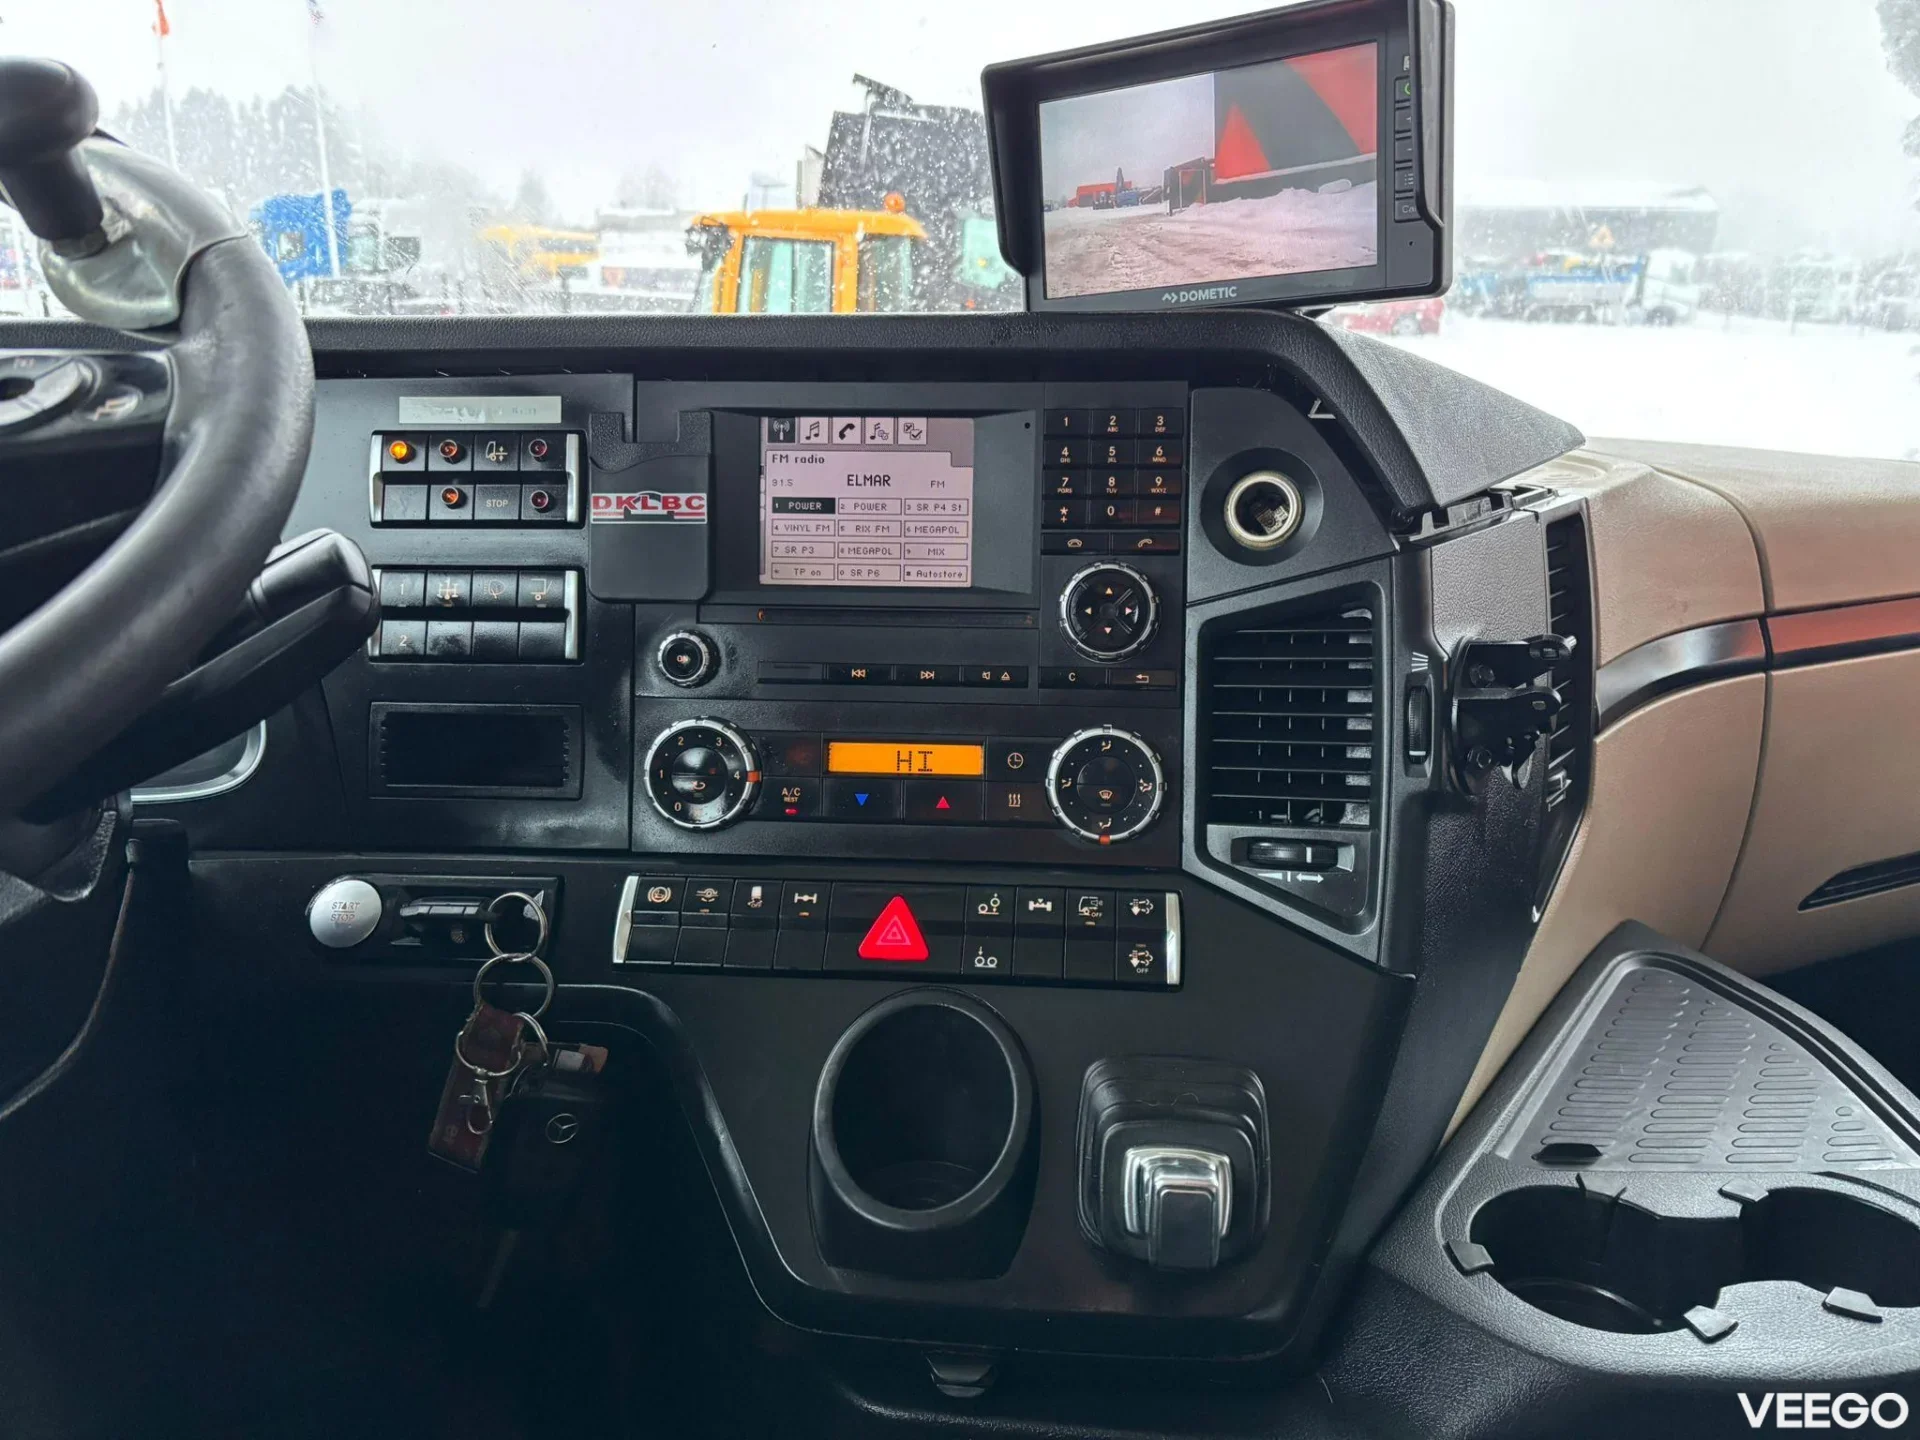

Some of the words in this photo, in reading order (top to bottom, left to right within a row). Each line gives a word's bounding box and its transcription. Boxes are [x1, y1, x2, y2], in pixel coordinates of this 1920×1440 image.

[1180, 286, 1237, 303] DOMETIC
[1063, 417, 1069, 427] 1
[1109, 415, 1117, 426] 2
[1156, 415, 1164, 426] 3
[1061, 446, 1069, 457] 4
[1108, 446, 1116, 456] 5
[1156, 445, 1163, 456] 6
[772, 454, 789, 464] FM
[795, 454, 825, 464] radio
[847, 474, 891, 488] ELMAR
[930, 480, 945, 489] FM
[1061, 477, 1069, 487] 7
[1108, 476, 1116, 487] 8
[1155, 476, 1163, 487] 9
[486, 499, 509, 508] STOP
[592, 495, 705, 510] DKLBC
[788, 501, 822, 511] POWER
[853, 502, 887, 511] POWER
[916, 503, 929, 512] SR
[934, 503, 946, 511] P4
[1106, 505, 1115, 516] 0
[784, 524, 811, 532] VINYL
[815, 524, 830, 532] FM
[855, 525, 871, 533] RIX
[875, 525, 890, 533] FM
[914, 526, 960, 534] MEGAPOL
[784, 546, 797, 554] SR
[801, 546, 814, 554] P3
[847, 546, 892, 555] MEGAPOL
[927, 548, 945, 556] MIX
[793, 568, 806, 576] TP
[810, 569, 822, 577] on
[850, 568, 863, 577] SR
[867, 569, 880, 577] P6
[916, 569, 963, 579] Autostore
[399, 635, 407, 647] 2
[1068, 672, 1076, 682] C
[678, 736, 684, 746] 2
[715, 736, 722, 747] 3
[896, 750, 933, 772] HI
[659, 769, 664, 779] 1
[734, 771, 741, 780] 4
[781, 787, 801, 797] A/C
[674, 801, 682, 812] 0
[331, 901, 361, 911] START
[330, 913, 355, 923] STOP
